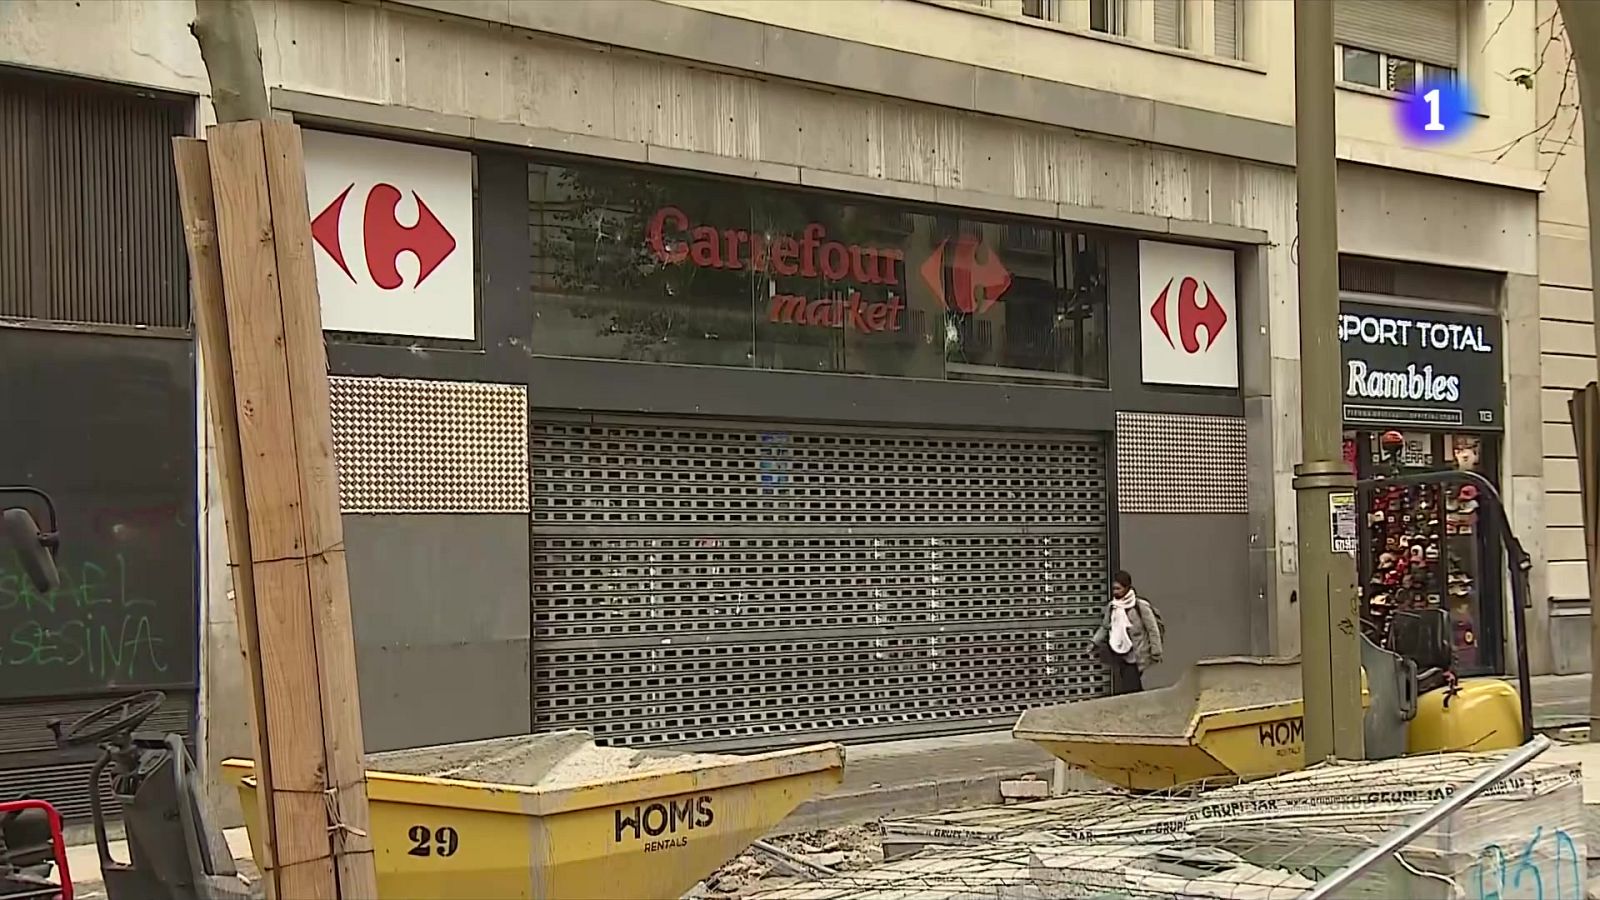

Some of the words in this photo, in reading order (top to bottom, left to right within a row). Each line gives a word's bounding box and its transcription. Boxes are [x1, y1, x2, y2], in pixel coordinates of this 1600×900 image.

[645, 205, 904, 286] Carrefour
[769, 290, 905, 334] market
[1416, 321, 1492, 352] TOTAL
[1347, 360, 1460, 402] Rambles
[0, 612, 169, 680] SESINA
[614, 796, 715, 842] HOMS
[407, 825, 459, 857] 29
[644, 837, 688, 853] RENTALS
